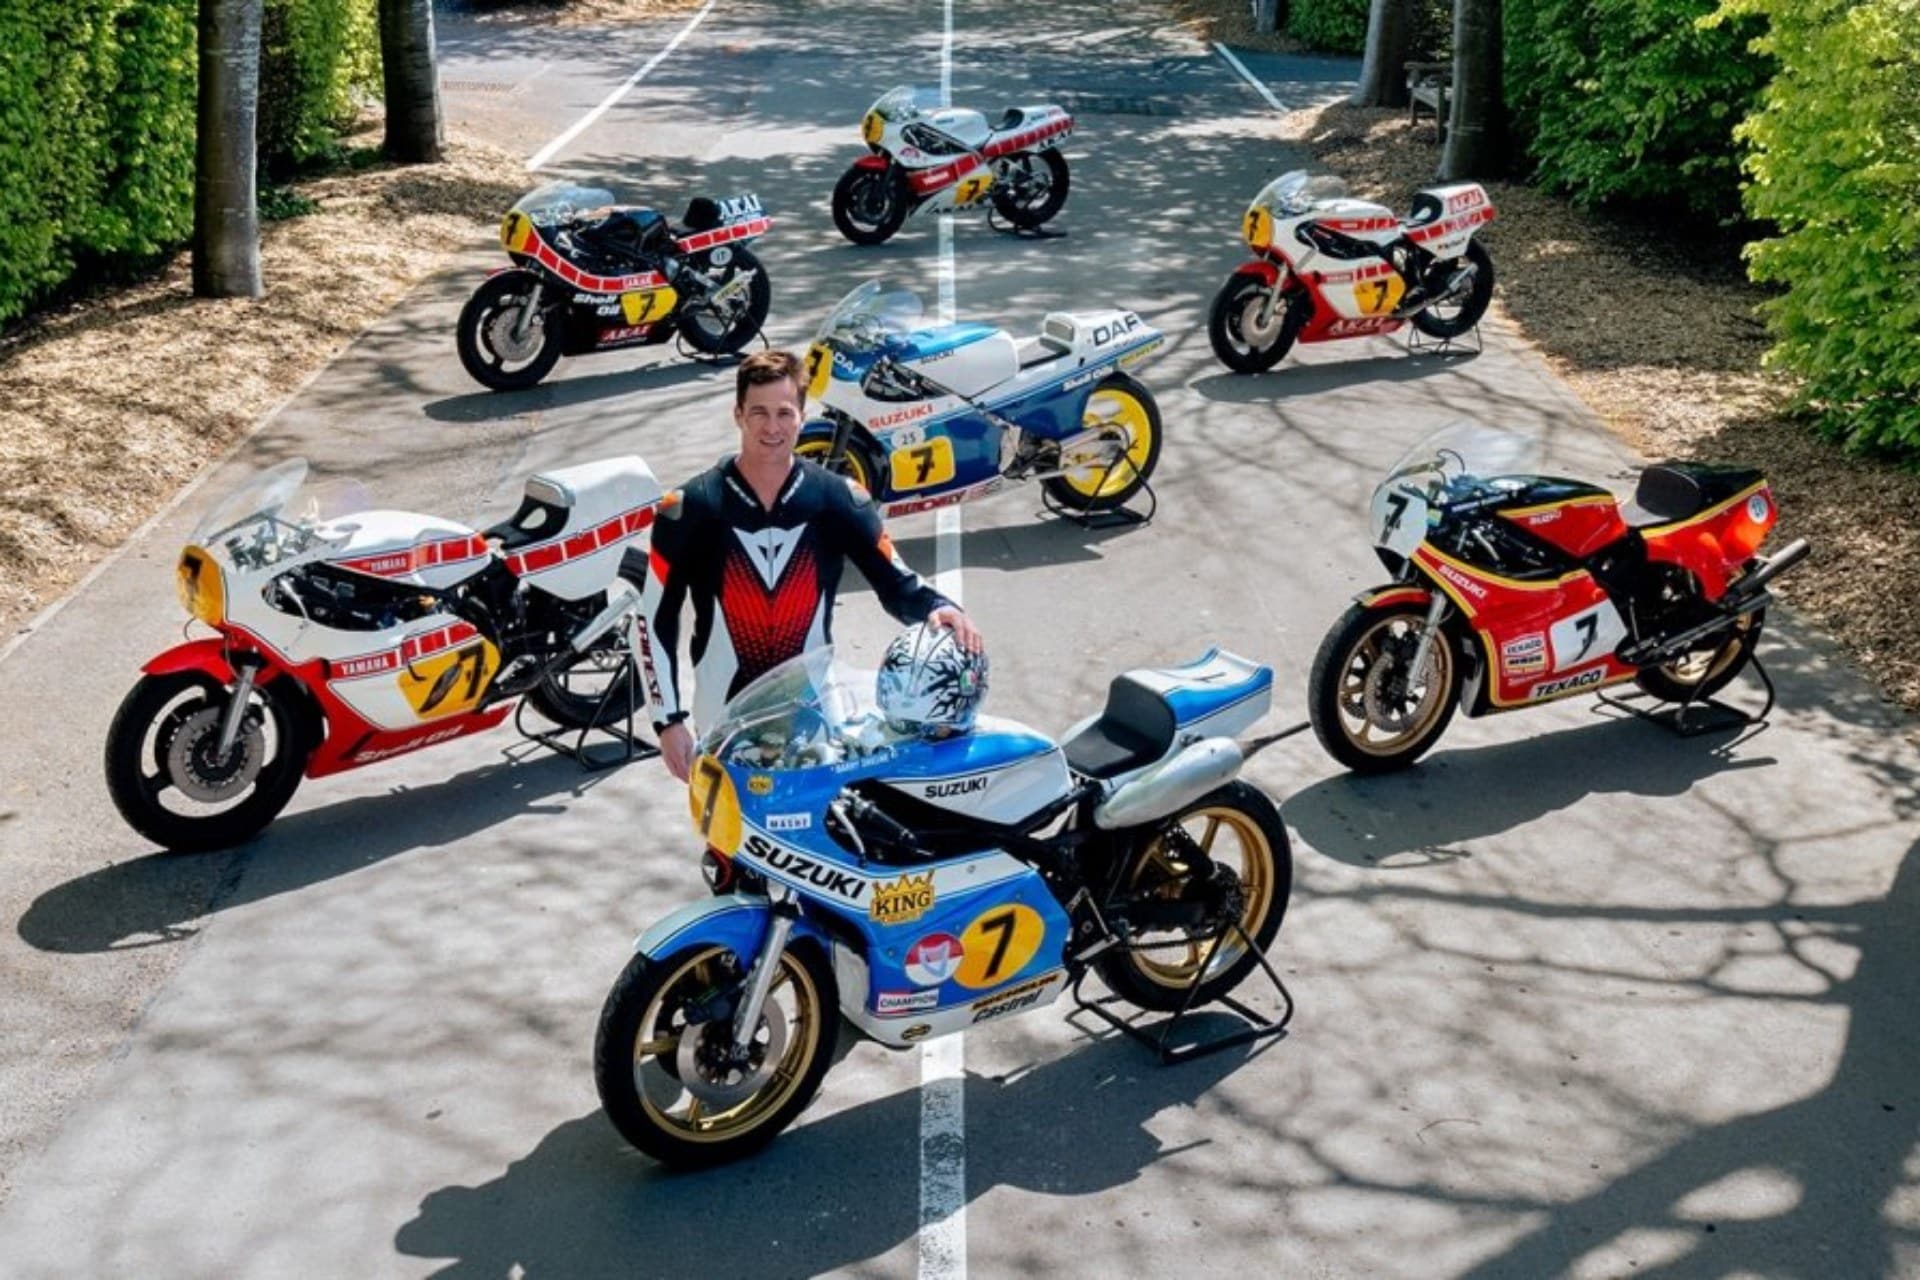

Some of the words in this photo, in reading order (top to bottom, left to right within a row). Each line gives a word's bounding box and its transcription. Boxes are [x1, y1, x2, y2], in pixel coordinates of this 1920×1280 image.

[966, 179, 980, 202] 7
[716, 192, 763, 221] AKAI
[505, 213, 521, 246] 7
[1249, 210, 1259, 242] 7
[573, 294, 617, 304] Shell
[639, 293, 655, 321] 7
[1373, 280, 1389, 311] 7
[601, 326, 651, 342] AKAI
[1093, 313, 1138, 346] DAF
[868, 404, 934, 428] SUZUKI
[910, 447, 935, 484] 7
[1379, 493, 1409, 545] 7
[179, 553, 204, 612] 7
[1438, 563, 1488, 599] SUZUKI
[1572, 611, 1599, 662] 7
[341, 654, 390, 676] YAMAHA
[458, 642, 485, 700] 7
[1535, 668, 1602, 698] TEXACO
[354, 736, 425, 762] Shell
[700, 760, 723, 838] 7
[925, 776, 988, 799] SUZUKI
[744, 834, 867, 900] SUZUKI
[874, 889, 932, 917] KING
[981, 908, 1017, 982] 7
[879, 992, 938, 1010] CHAMPION
[972, 987, 1045, 1025] Castrol
